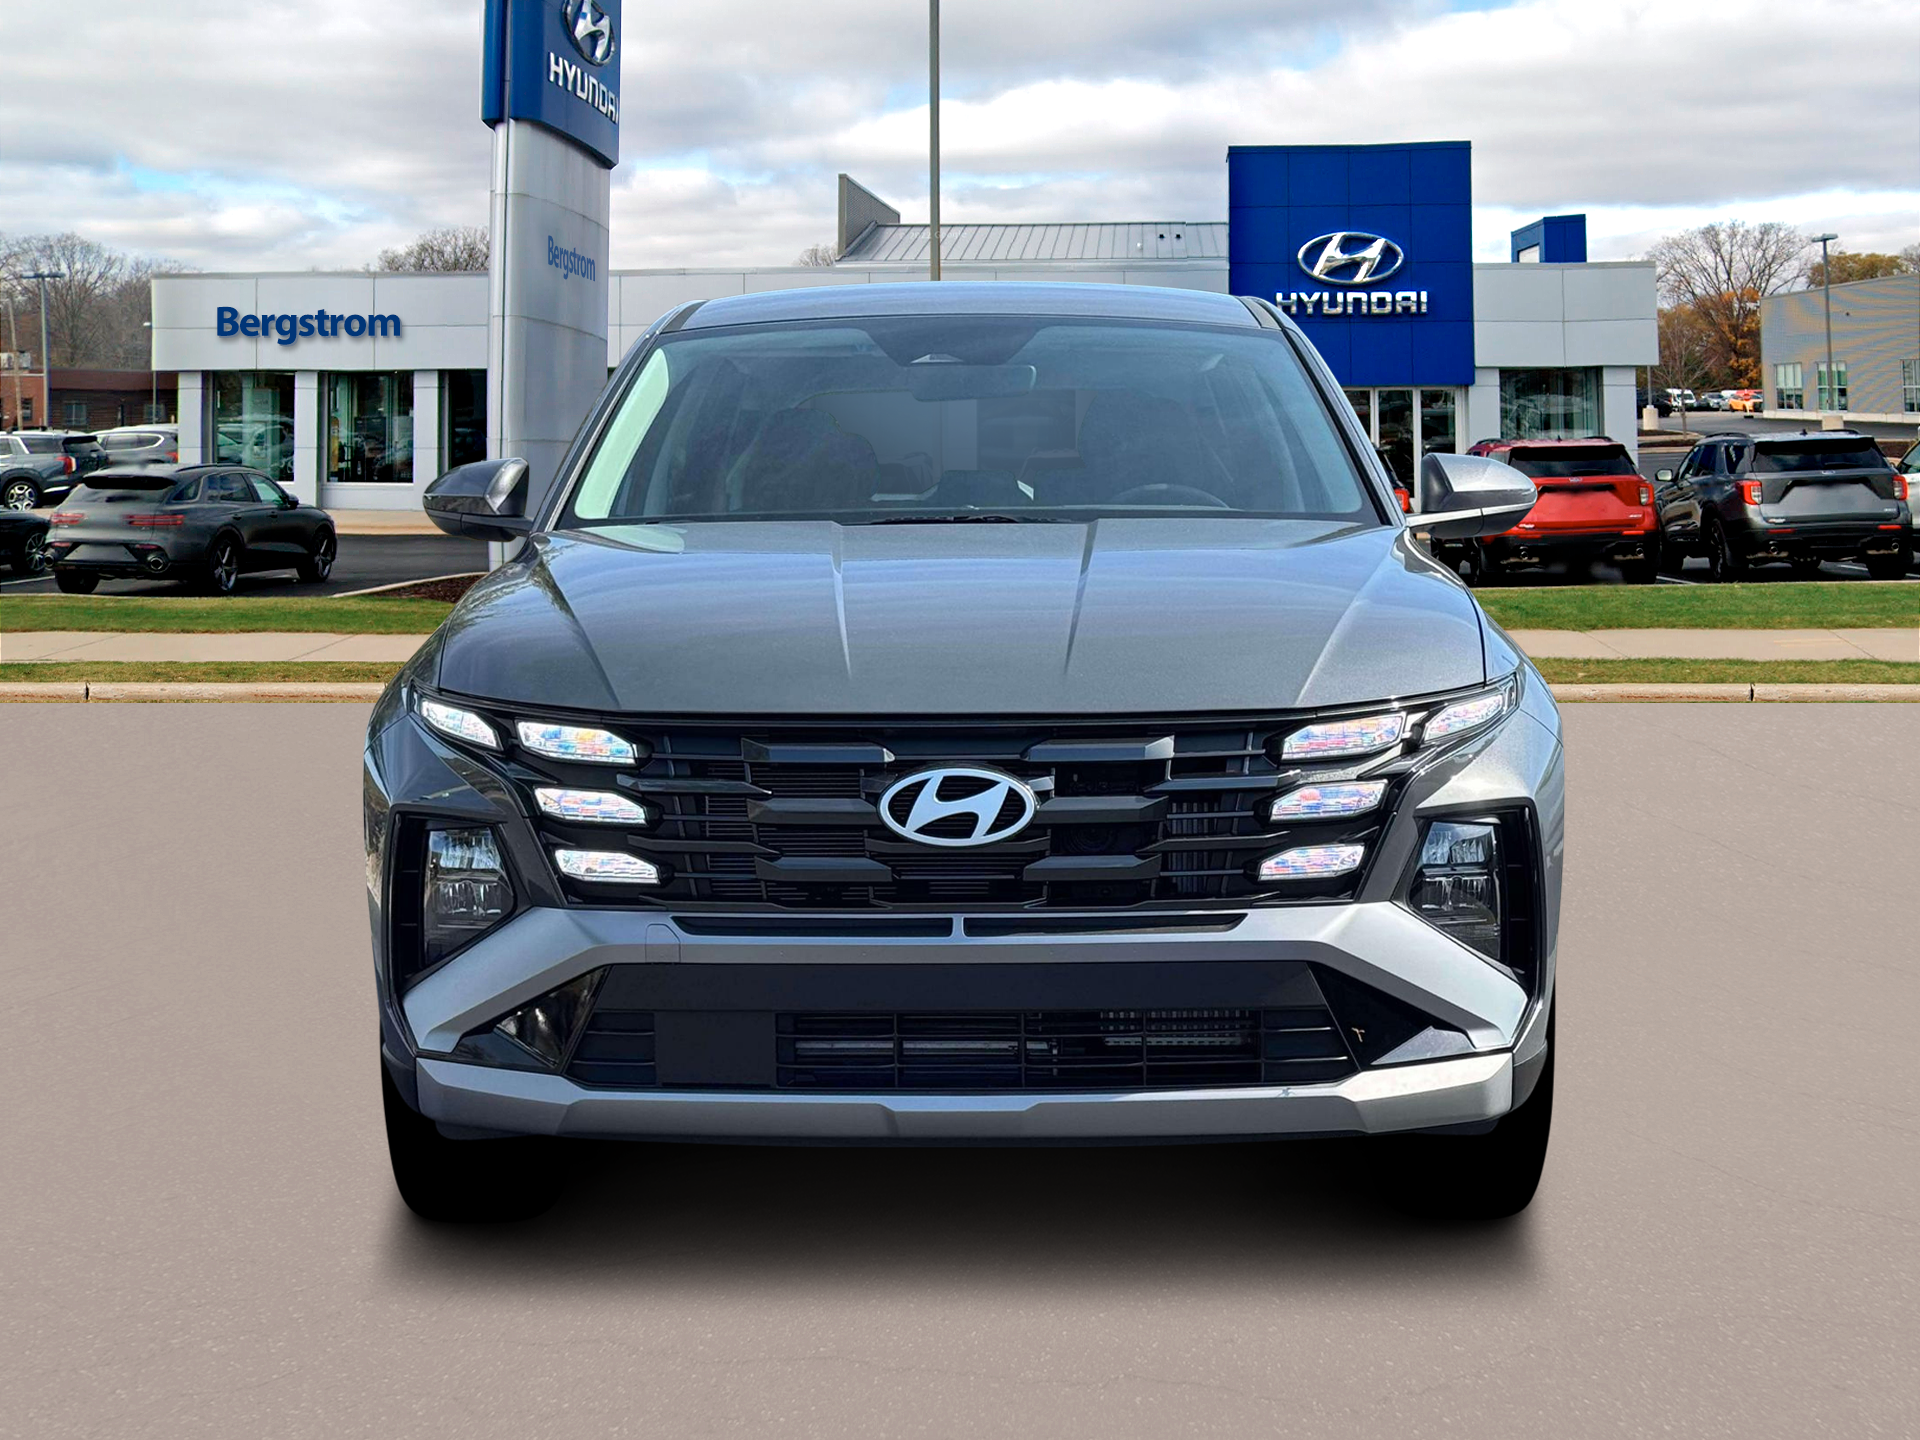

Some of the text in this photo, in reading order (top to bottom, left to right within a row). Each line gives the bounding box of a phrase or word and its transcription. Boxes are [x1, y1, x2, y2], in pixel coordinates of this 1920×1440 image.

[549, 52, 618, 124] HYUNDAI
[548, 235, 595, 282] Bergstrom
[1276, 291, 1428, 315] HYUNDAI
[217, 306, 401, 345] Bergstrom
